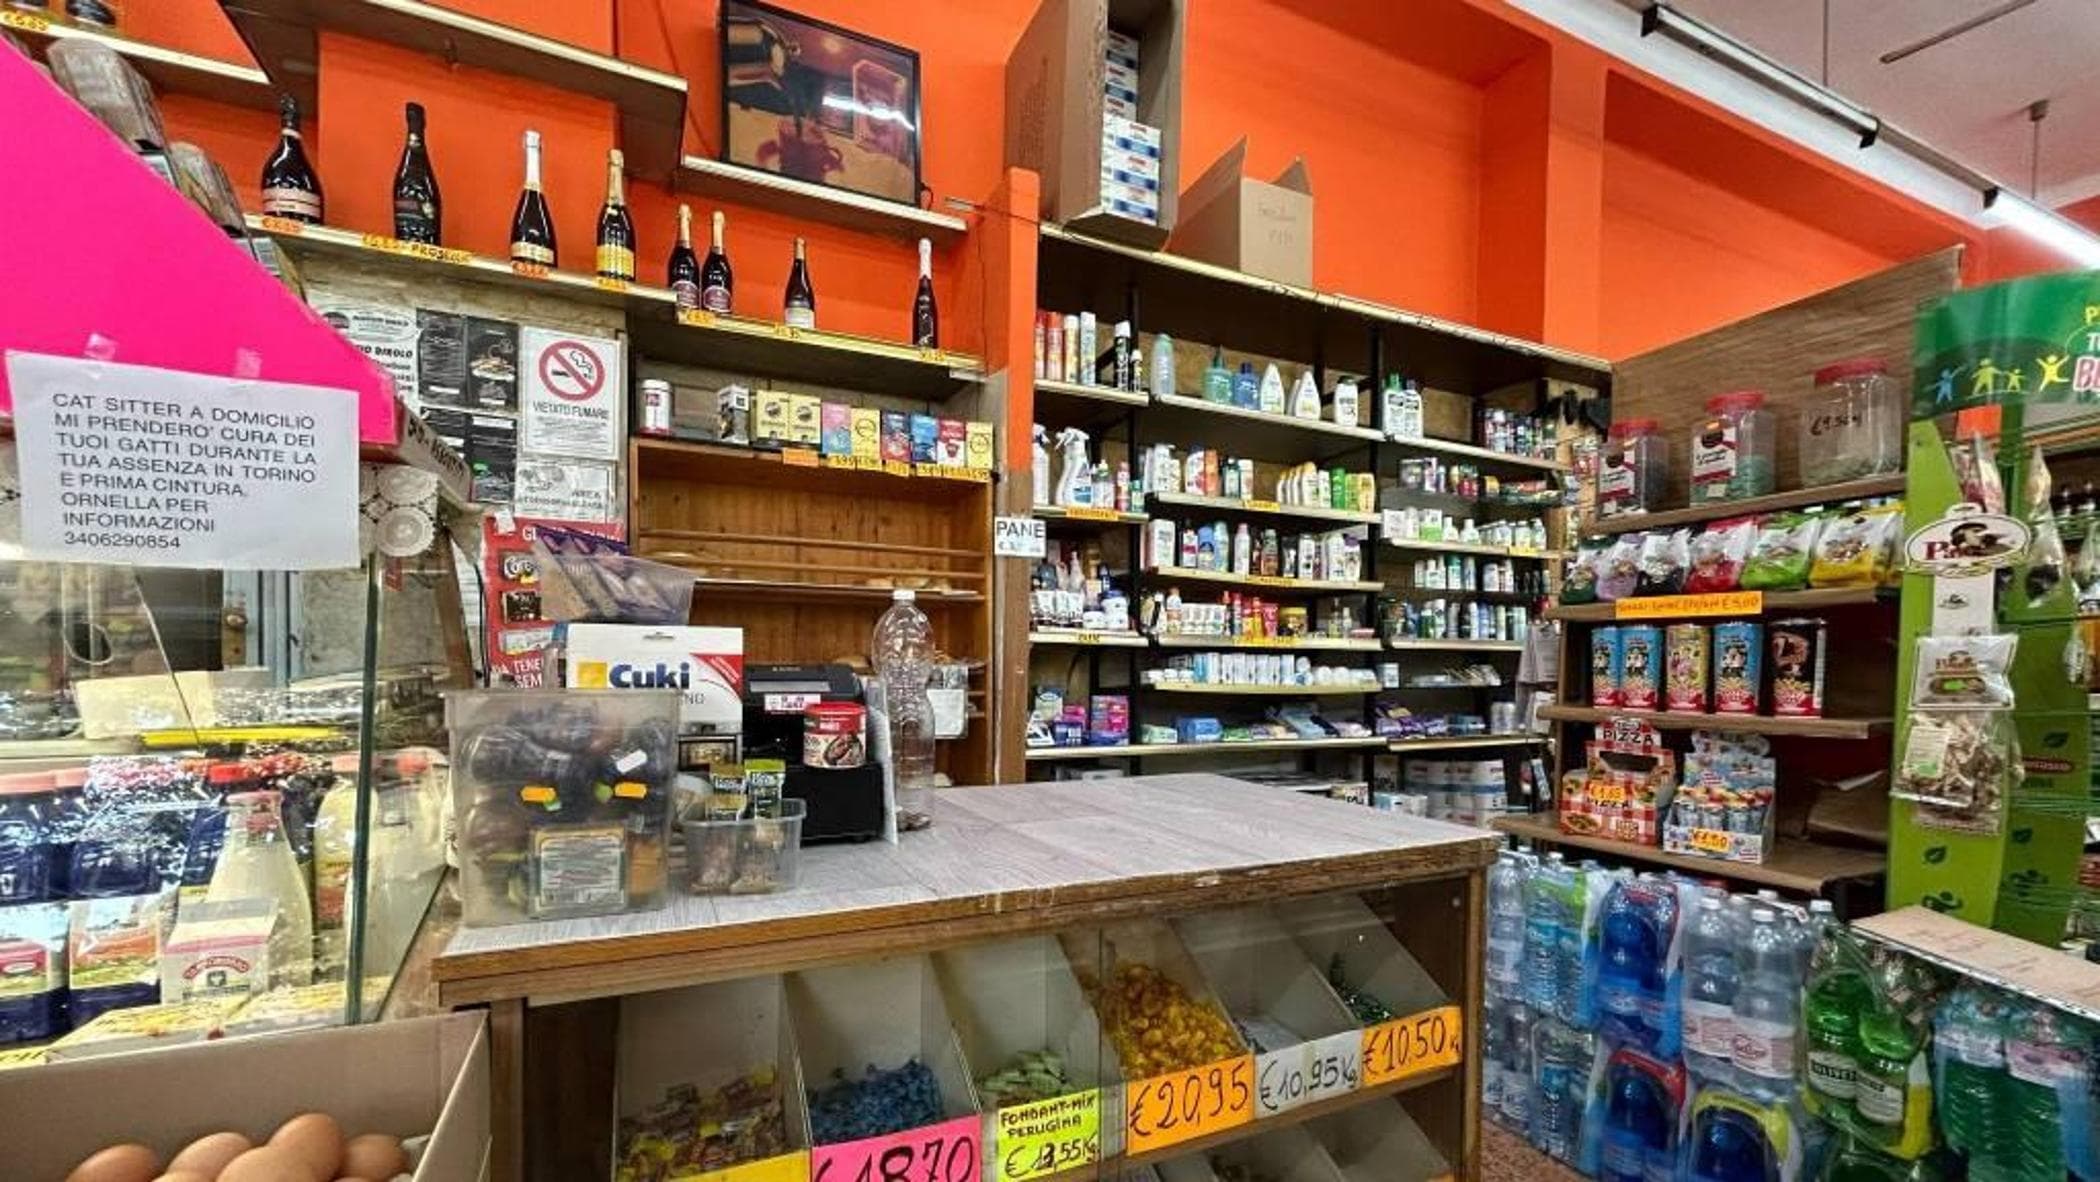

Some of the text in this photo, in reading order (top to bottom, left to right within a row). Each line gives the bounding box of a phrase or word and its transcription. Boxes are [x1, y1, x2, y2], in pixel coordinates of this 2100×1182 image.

[52, 393, 316, 431] CAT SITTER A DOMICILIO
[53, 412, 316, 448] MI PRENDERO' CURA DEI
[55, 432, 317, 465] TUOI GATTI DURANTE LA
[57, 452, 316, 484] TUA ASSENZA IN TORINO
[60, 472, 75, 487] E
[80, 474, 147, 492] PRIMA
[61, 492, 209, 514] ORNELLA PER
[63, 512, 215, 532] INFORMAZIONI
[996, 520, 1044, 538] PANE
[64, 532, 181, 549] 3406290854
[609, 661, 690, 688] Cuki
[1603, 730, 1654, 745] PIZZA
